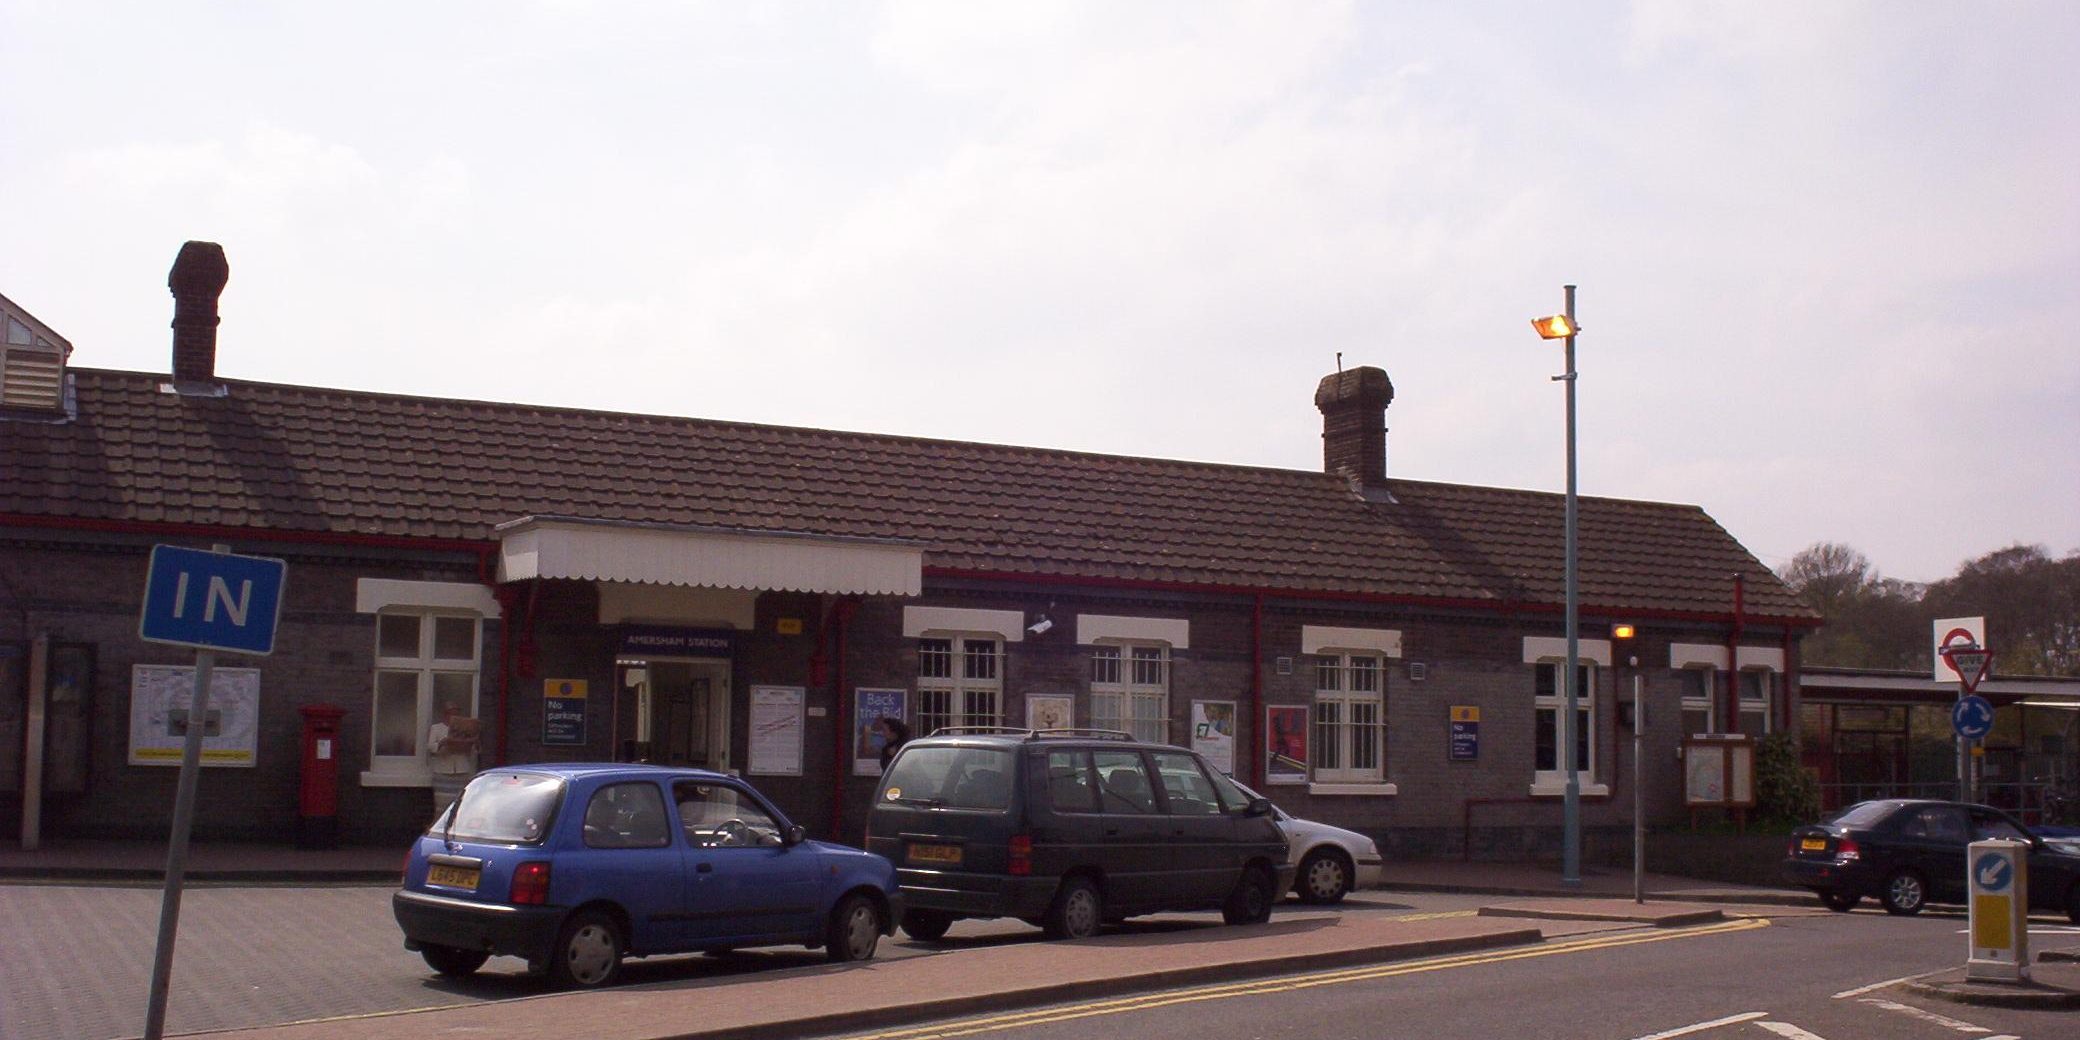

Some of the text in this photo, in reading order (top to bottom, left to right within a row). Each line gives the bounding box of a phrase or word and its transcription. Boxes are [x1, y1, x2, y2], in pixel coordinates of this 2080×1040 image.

[173, 571, 253, 627] IN
[628, 635, 728, 648] AMERSHAM STATION
[548, 700, 562, 710] No
[867, 692, 895, 706] Back
[547, 711, 583, 722] parking
[860, 707, 880, 719] the
